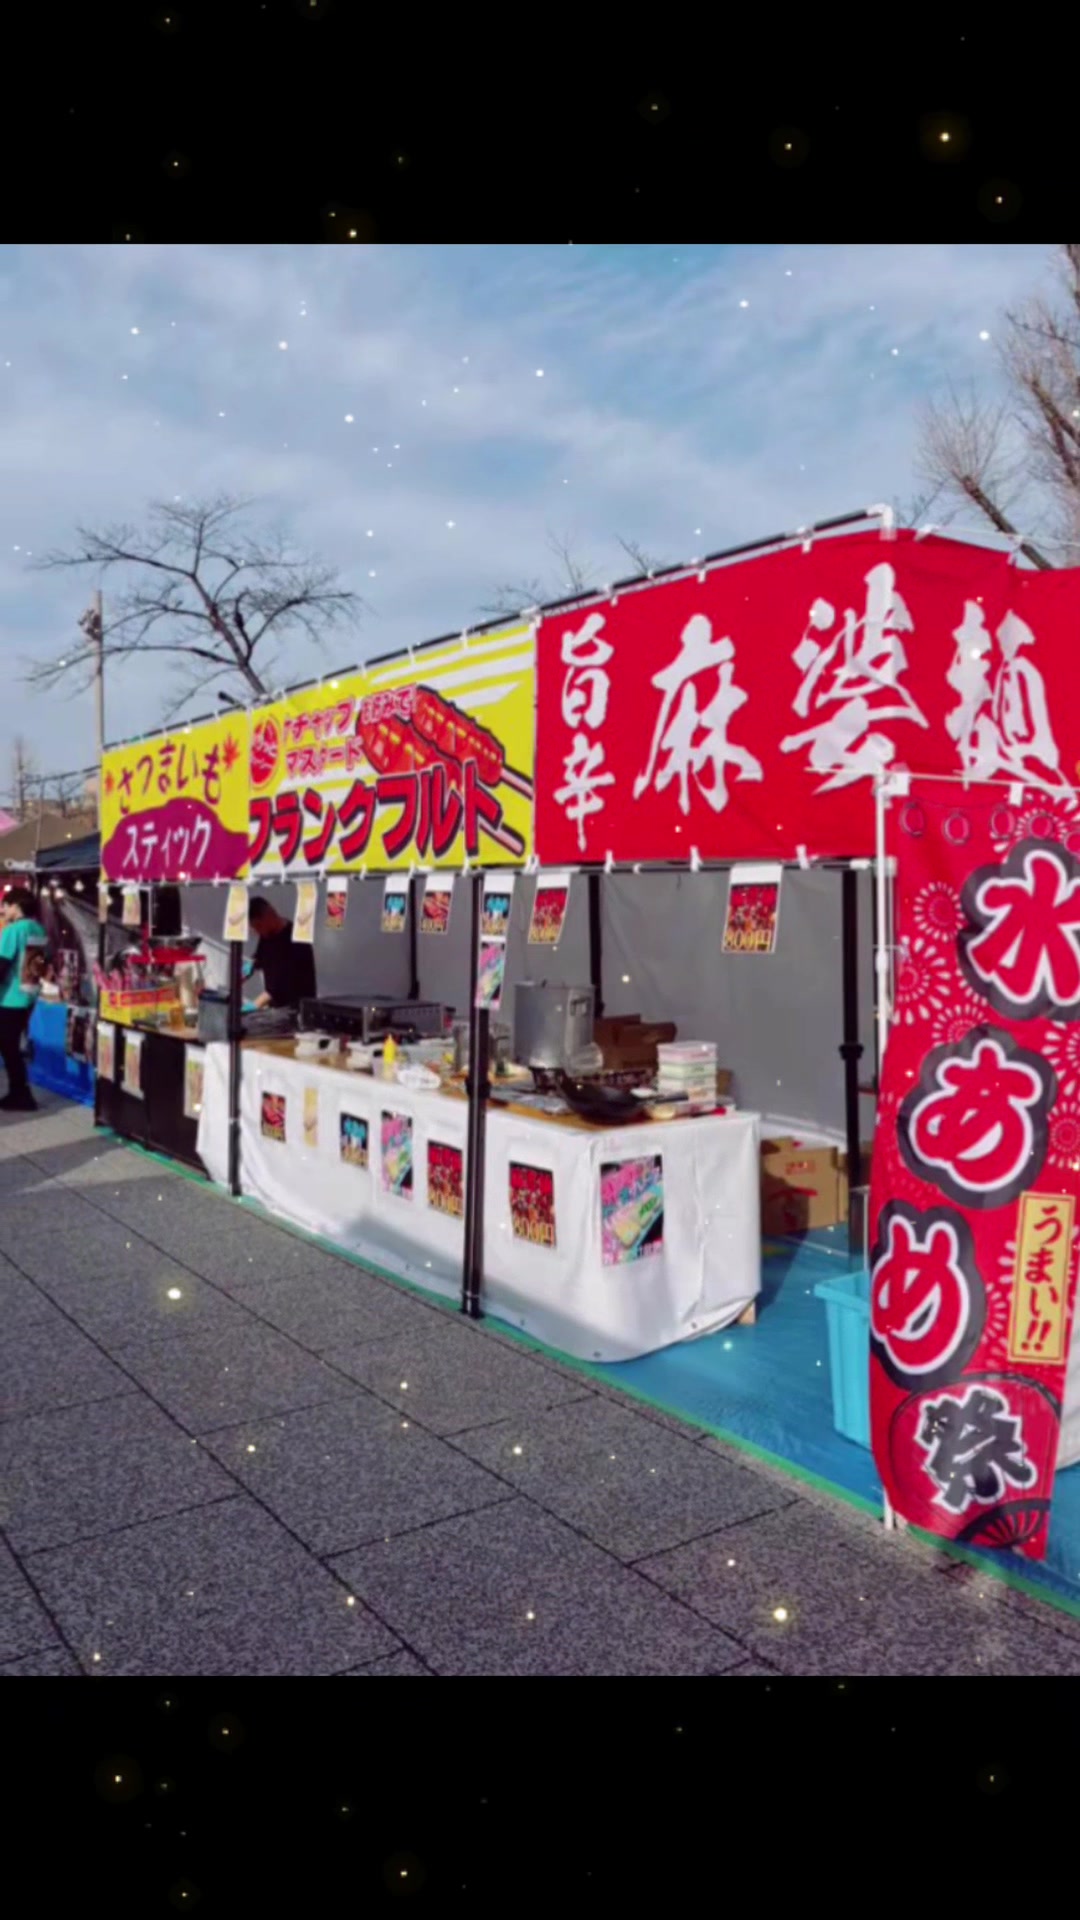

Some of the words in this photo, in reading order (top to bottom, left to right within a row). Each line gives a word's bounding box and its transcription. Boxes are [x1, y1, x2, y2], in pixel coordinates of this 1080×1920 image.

[554, 612, 615, 852] 旨辛
[116, 741, 222, 815] さつまいも
[247, 758, 504, 867] フランクフルト
[121, 813, 213, 870] スティック
